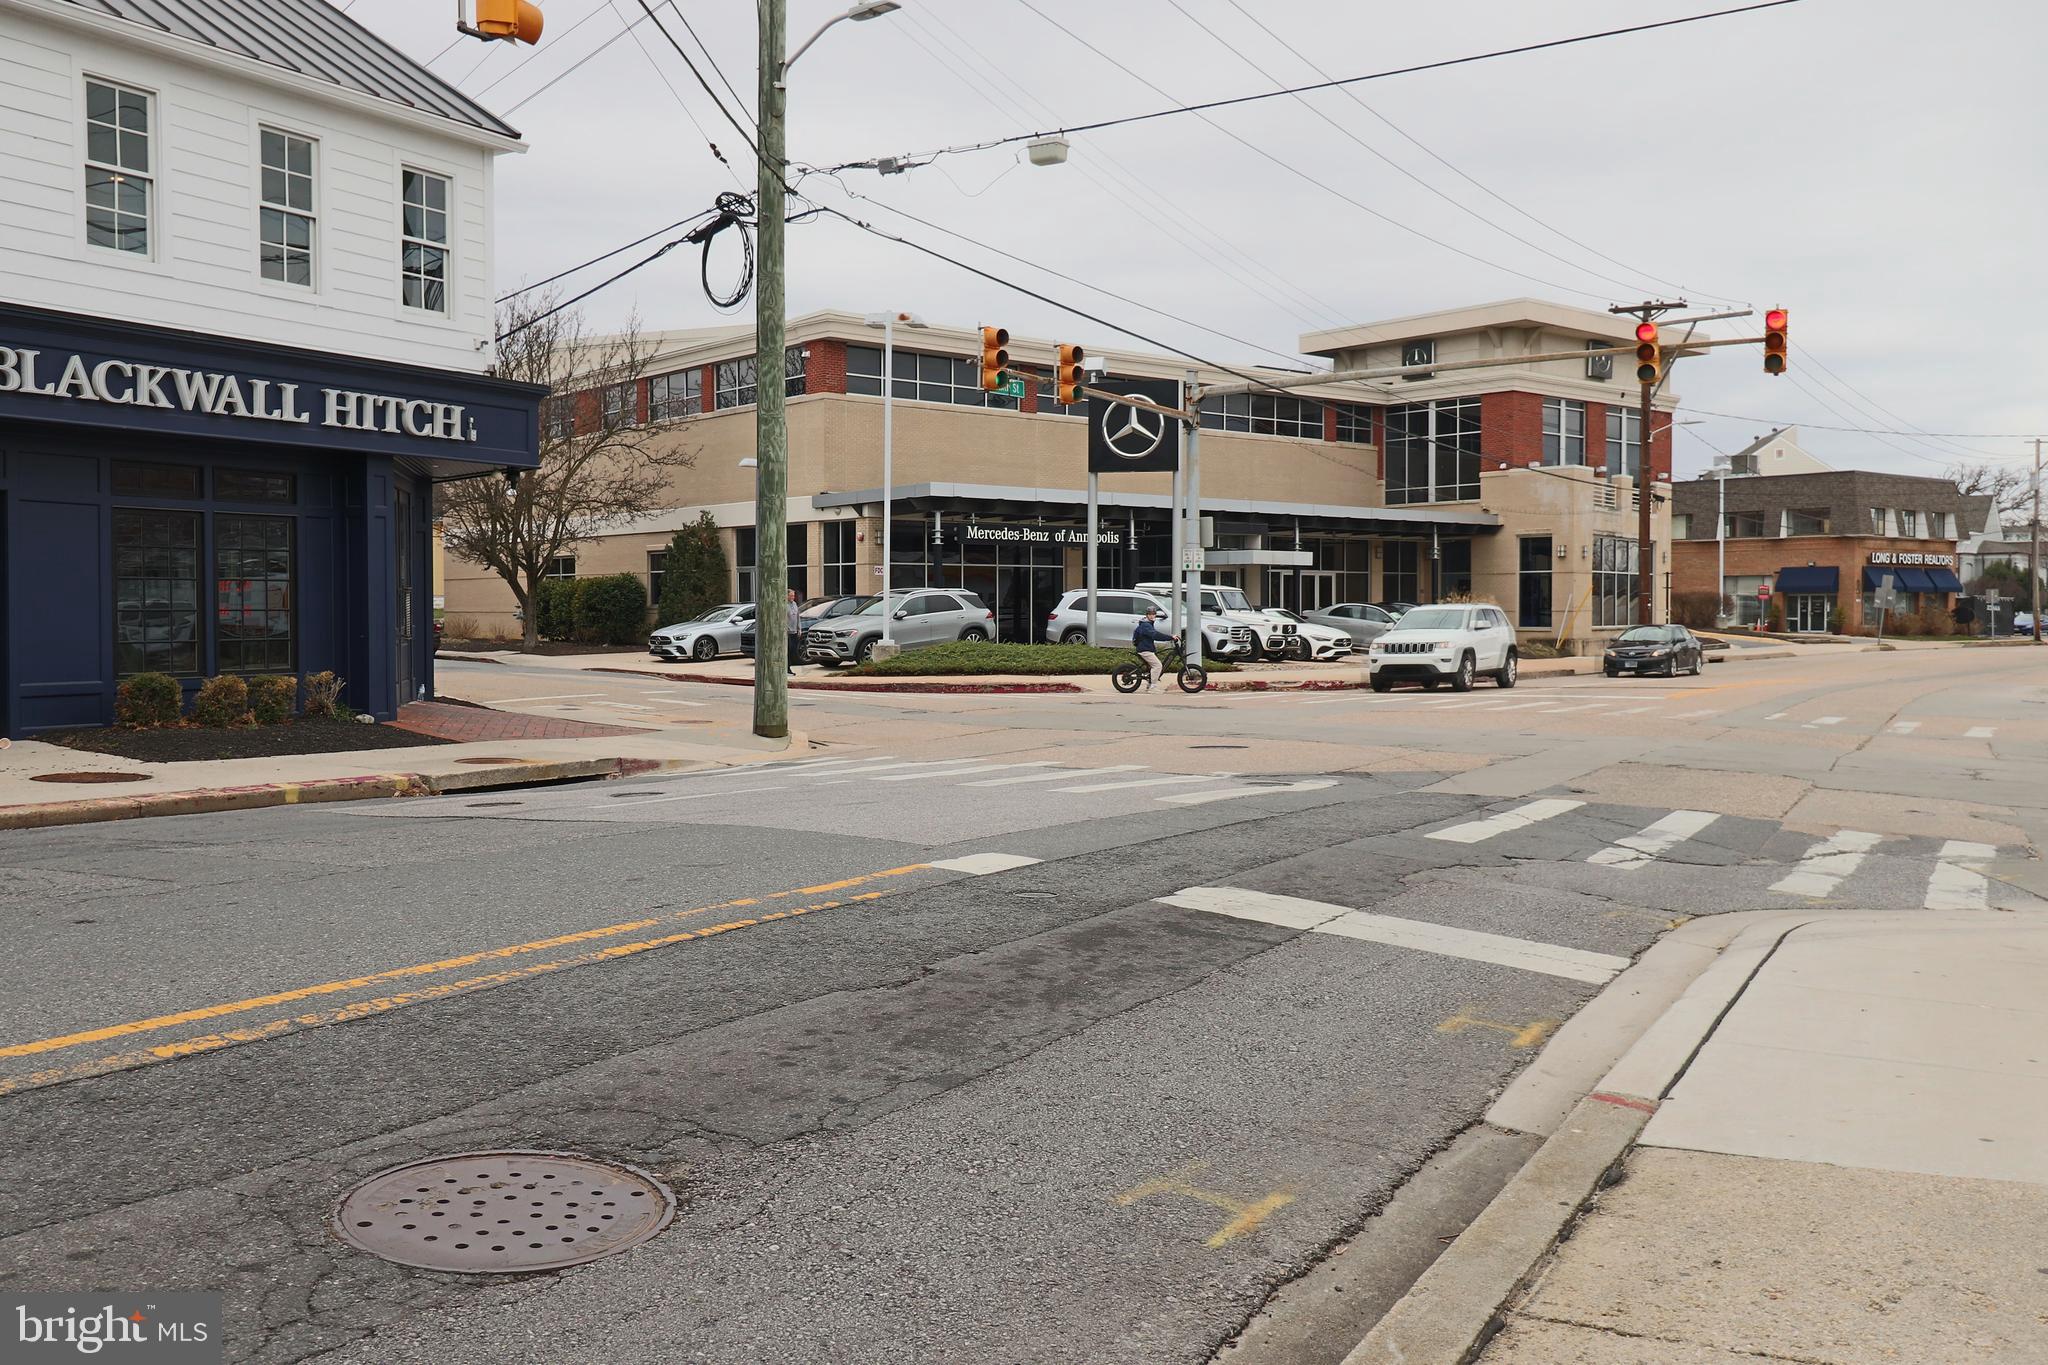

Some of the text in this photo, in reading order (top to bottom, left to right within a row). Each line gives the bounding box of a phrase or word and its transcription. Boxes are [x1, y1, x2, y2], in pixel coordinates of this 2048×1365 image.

[0, 346, 465, 441] BLACKWALL HITCH
[1012, 383, 1020, 394] St
[966, 526, 1119, 545] Mercedes-Benz of Annpolis
[1872, 552, 1953, 566] LONG & FOSTER REALTORS
